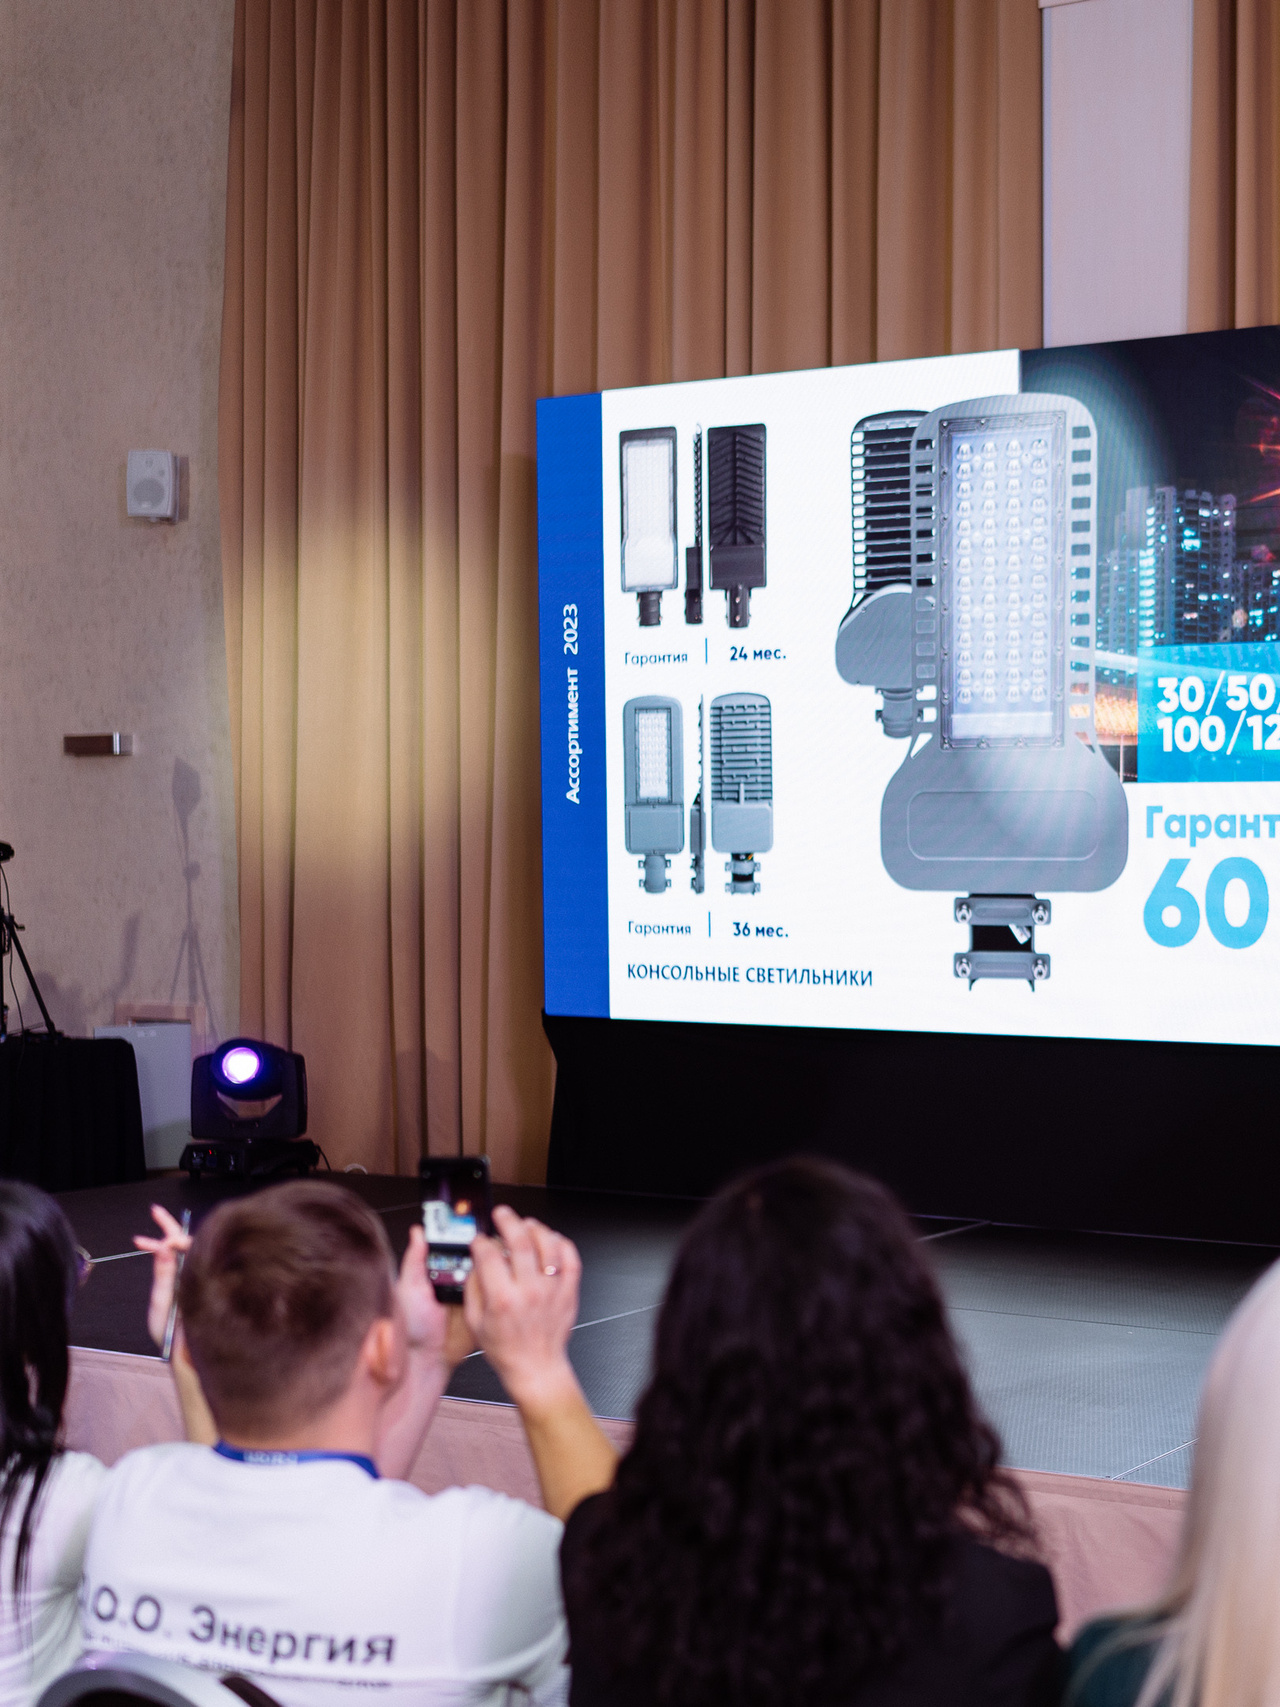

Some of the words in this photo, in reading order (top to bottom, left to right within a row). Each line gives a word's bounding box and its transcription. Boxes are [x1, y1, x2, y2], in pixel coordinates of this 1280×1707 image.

[563, 603, 579, 655] 2023
[624, 652, 689, 668] Гарантия
[729, 646, 748, 661] 24
[753, 648, 787, 660] мес.
[565, 667, 583, 805] Ассортимент
[627, 920, 692, 937] Гарантия
[732, 922, 751, 937] 36
[755, 924, 789, 938] мес.
[1143, 856, 1270, 950] 60
[627, 963, 740, 983] КОНСОЛЬНЫЕ
[746, 966, 873, 987] СВЕТИЛЬНИКИ
[188, 1604, 397, 1665] Энергия
